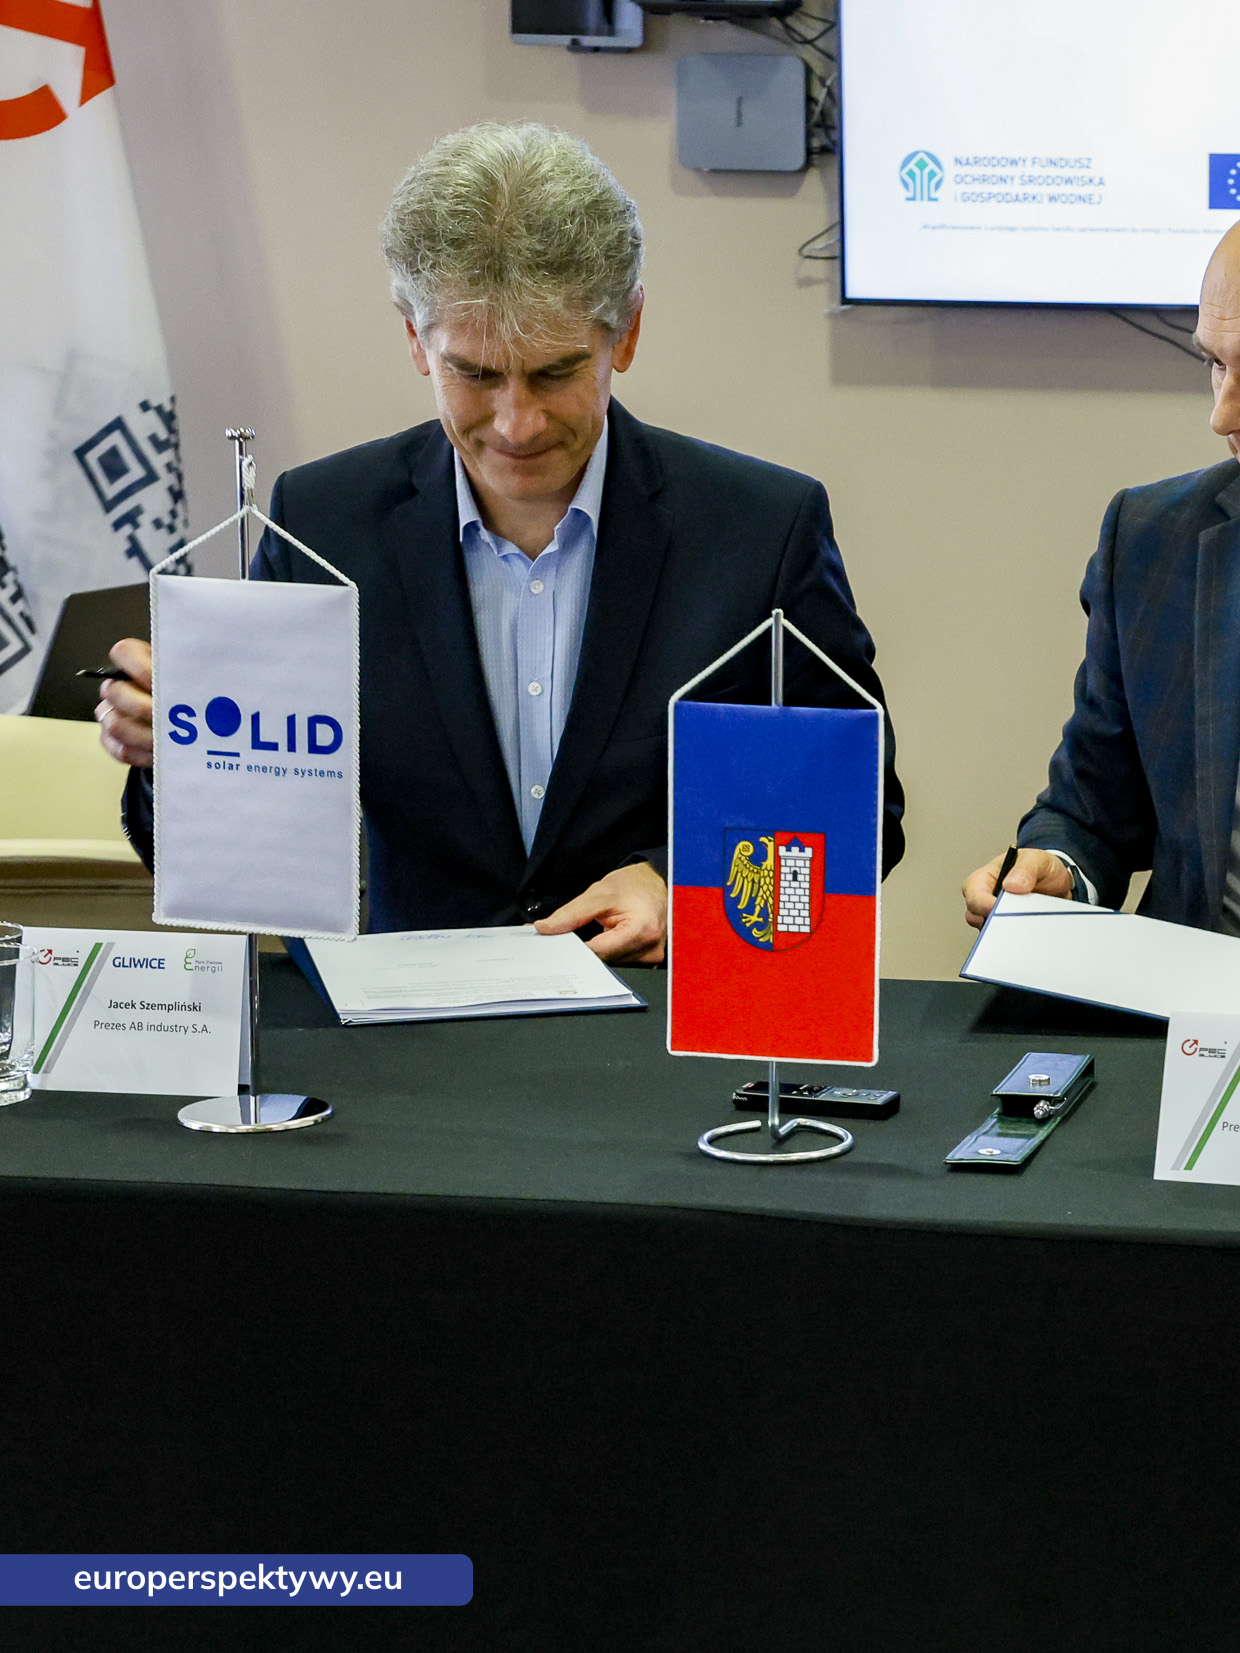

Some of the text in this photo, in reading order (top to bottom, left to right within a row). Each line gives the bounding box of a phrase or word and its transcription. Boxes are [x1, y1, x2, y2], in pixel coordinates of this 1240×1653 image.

[953, 156, 1093, 169] NARODOWY FUNDUSZ
[954, 171, 1106, 187] OCHRONY ŚRODOWISKA
[961, 192, 1044, 204] GOSPODARKI
[1047, 193, 1103, 205] WODNEJ
[168, 696, 343, 755] SOLID
[206, 760, 344, 780] solar energy systems
[112, 956, 166, 970] GLIWICE
[107, 999, 203, 1014] Jacek Szempliński
[93, 1019, 213, 1036] Prezes AB industry S.A.
